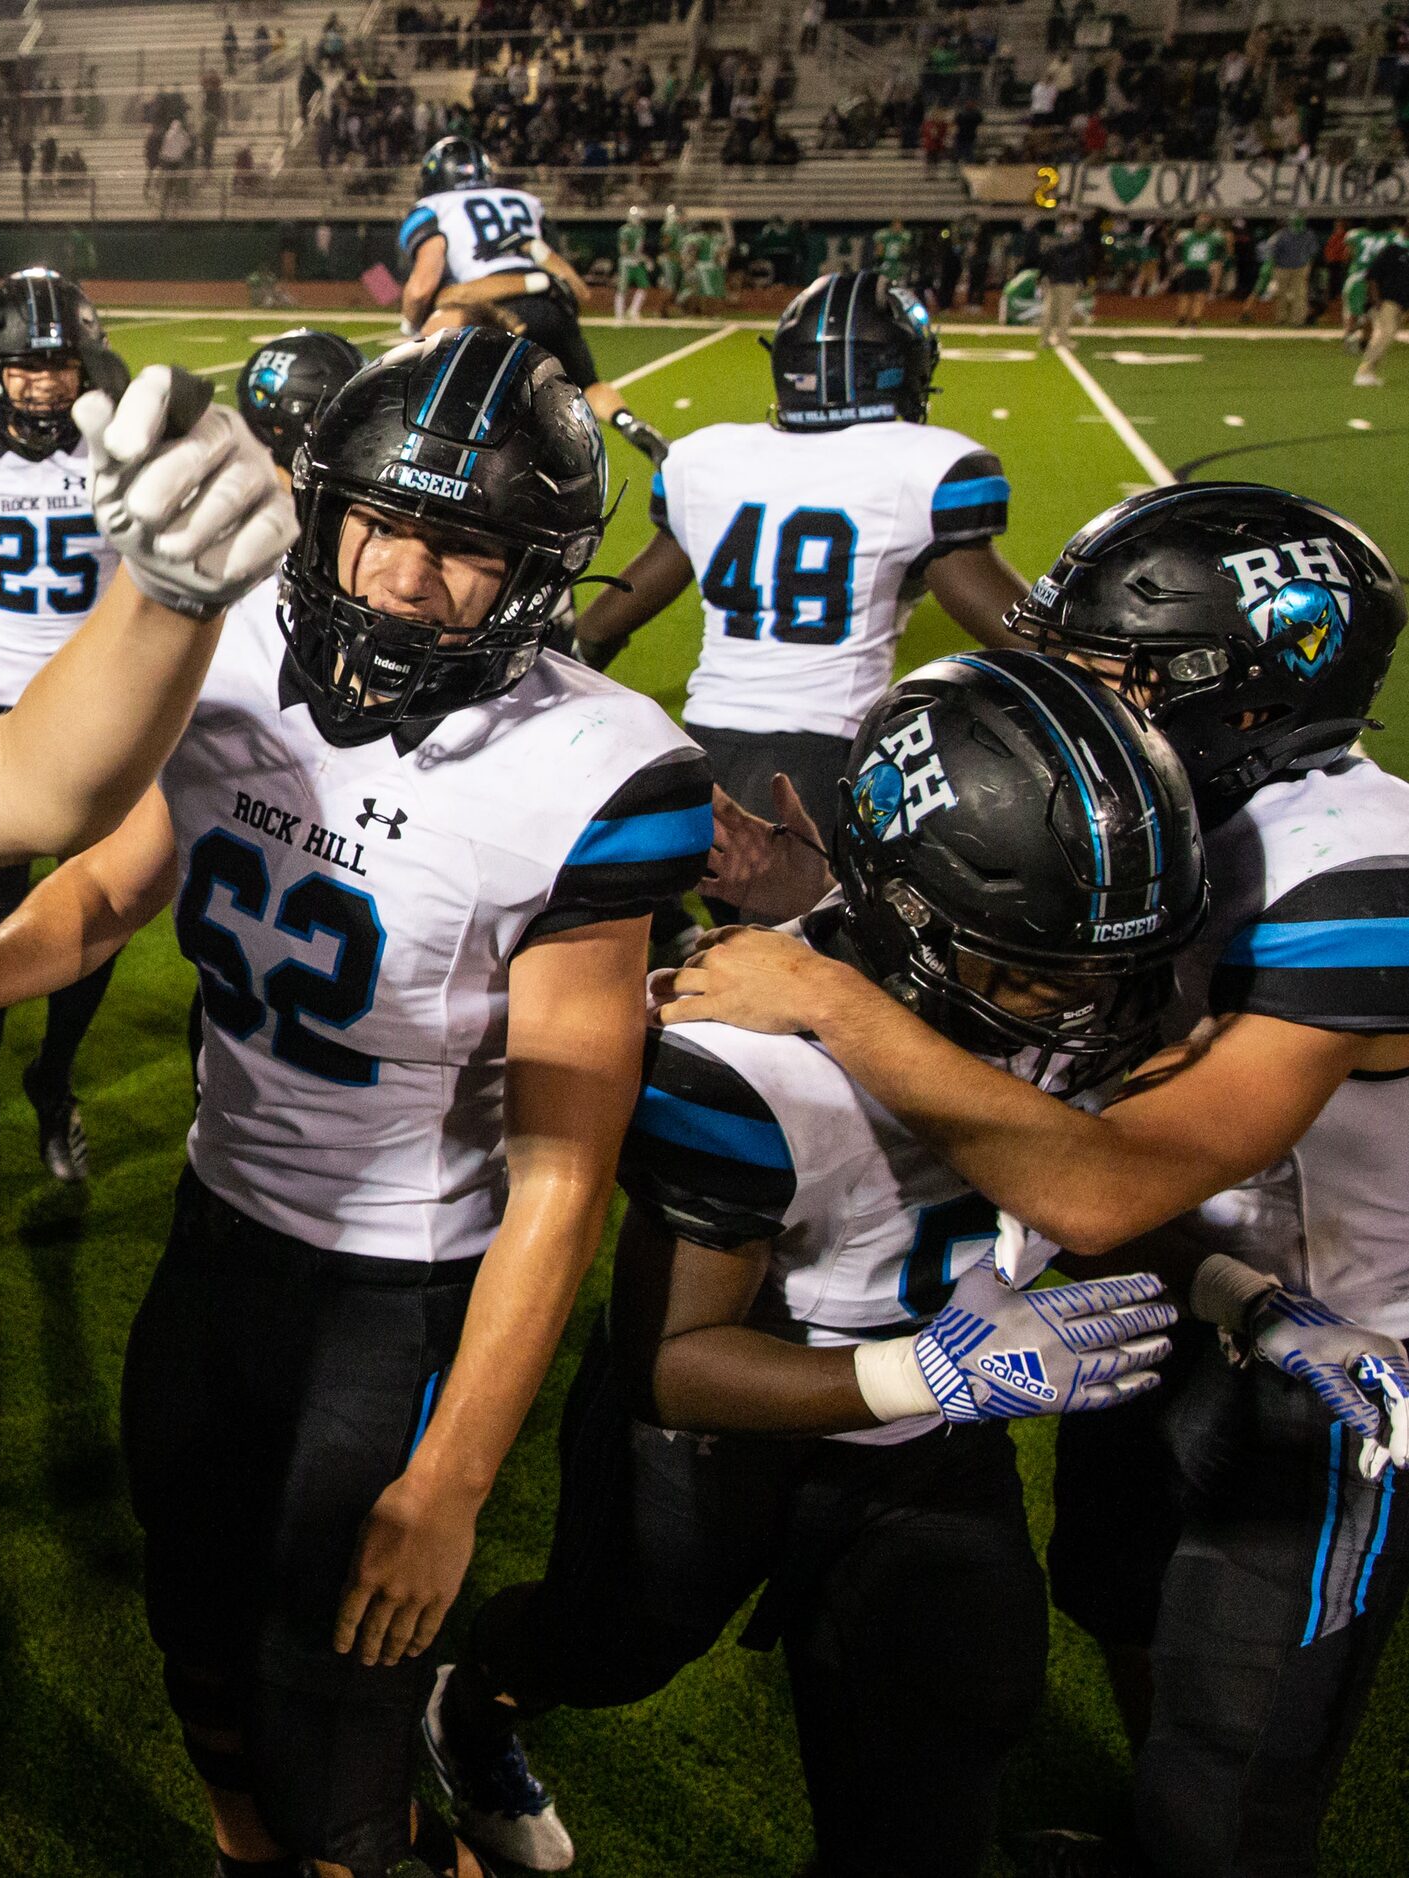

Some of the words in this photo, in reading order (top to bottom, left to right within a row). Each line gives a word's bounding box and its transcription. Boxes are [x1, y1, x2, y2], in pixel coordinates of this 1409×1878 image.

[1, 498, 41, 512] ROCK
[46, 495, 82, 510] HILL
[399, 465, 469, 501] ICSEEU
[700, 501, 859, 645] 48
[1221, 537, 1352, 608] RH
[879, 710, 960, 835] RH
[232, 791, 301, 845] ROCK
[302, 823, 367, 877] HILL
[170, 826, 388, 1088] 62
[1092, 914, 1159, 943] ICSEEU
[980, 1358, 1056, 1400] adidas
